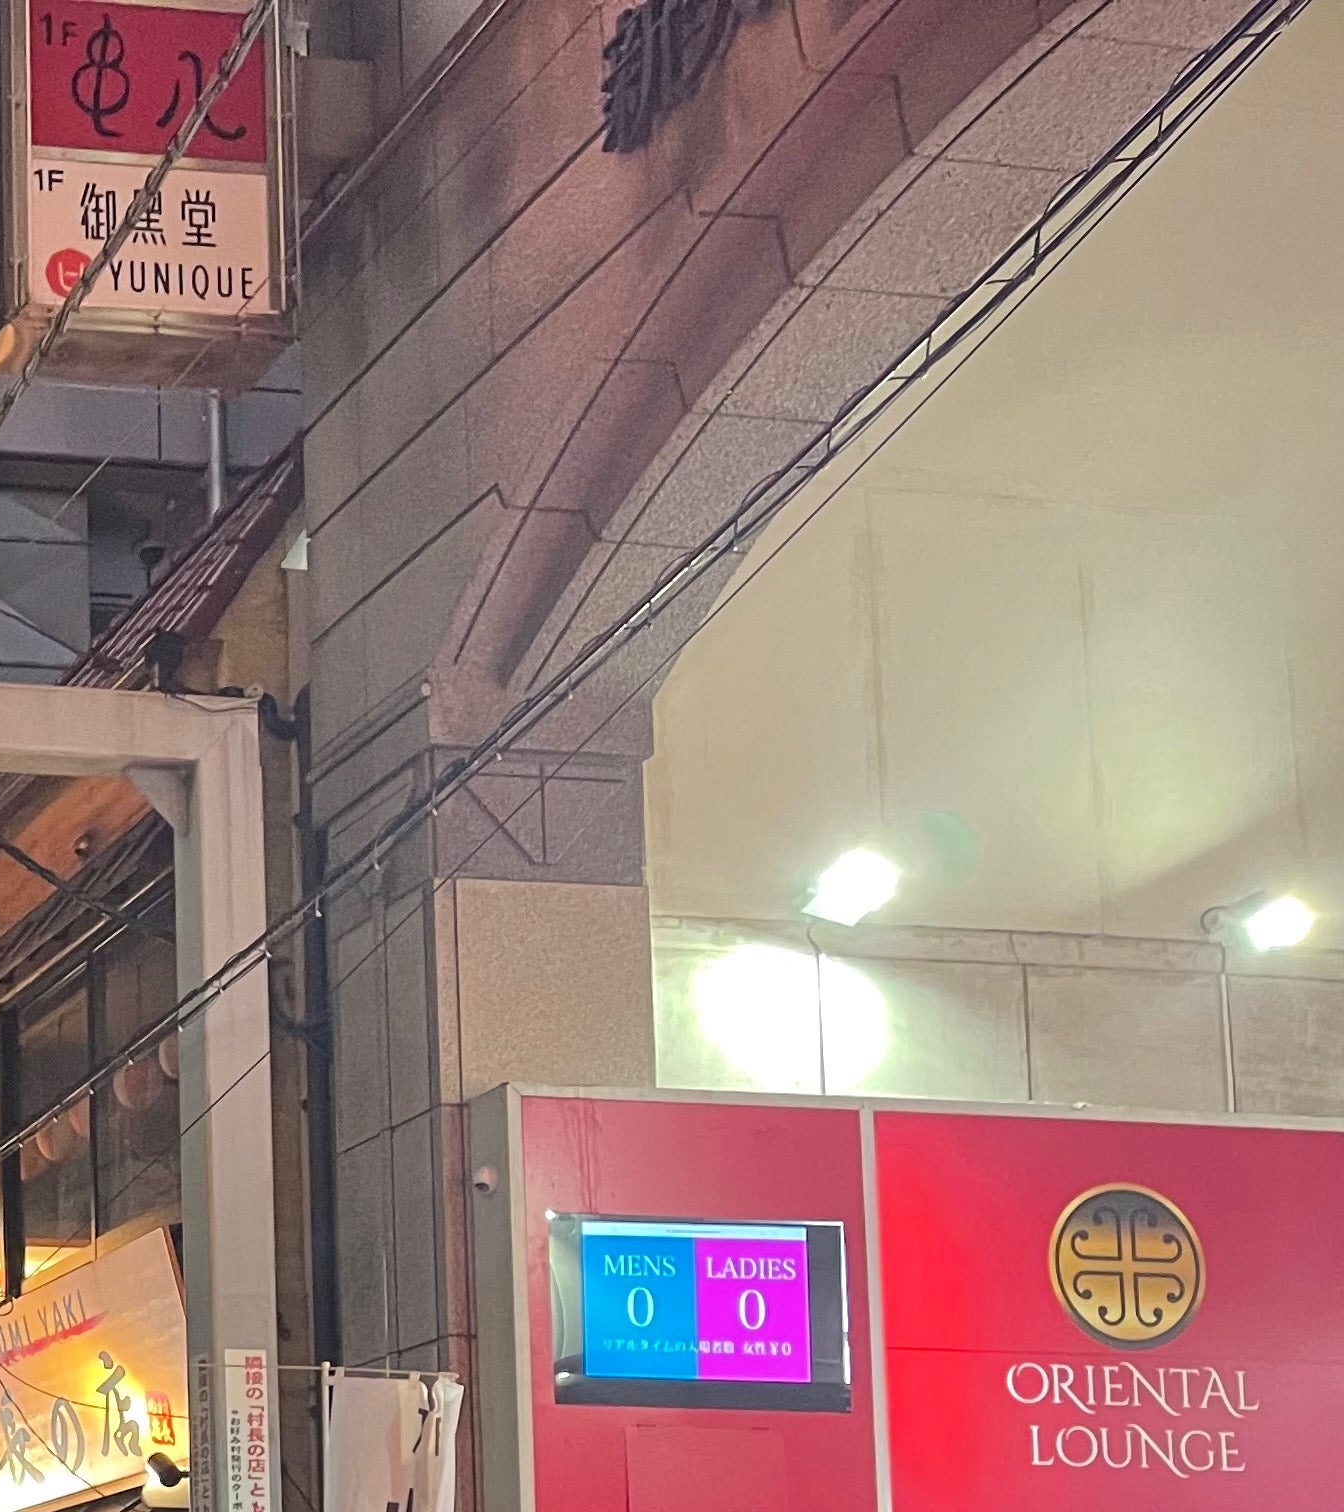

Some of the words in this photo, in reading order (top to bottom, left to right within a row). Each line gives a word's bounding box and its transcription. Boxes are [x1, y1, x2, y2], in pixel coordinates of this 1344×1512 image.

[40, 13, 79, 46] 1F
[33, 169, 64, 191] 1F
[110, 259, 254, 299] YUNIQUE
[603, 1254, 677, 1278] MENS
[705, 1256, 798, 1281] LADIES
[40, 1289, 87, 1335] YAKI
[627, 1286, 655, 1328] 0
[738, 1289, 767, 1331] 0
[1006, 1361, 1260, 1418] ORIENTAL
[1030, 1424, 1247, 1479] LOUNGE
